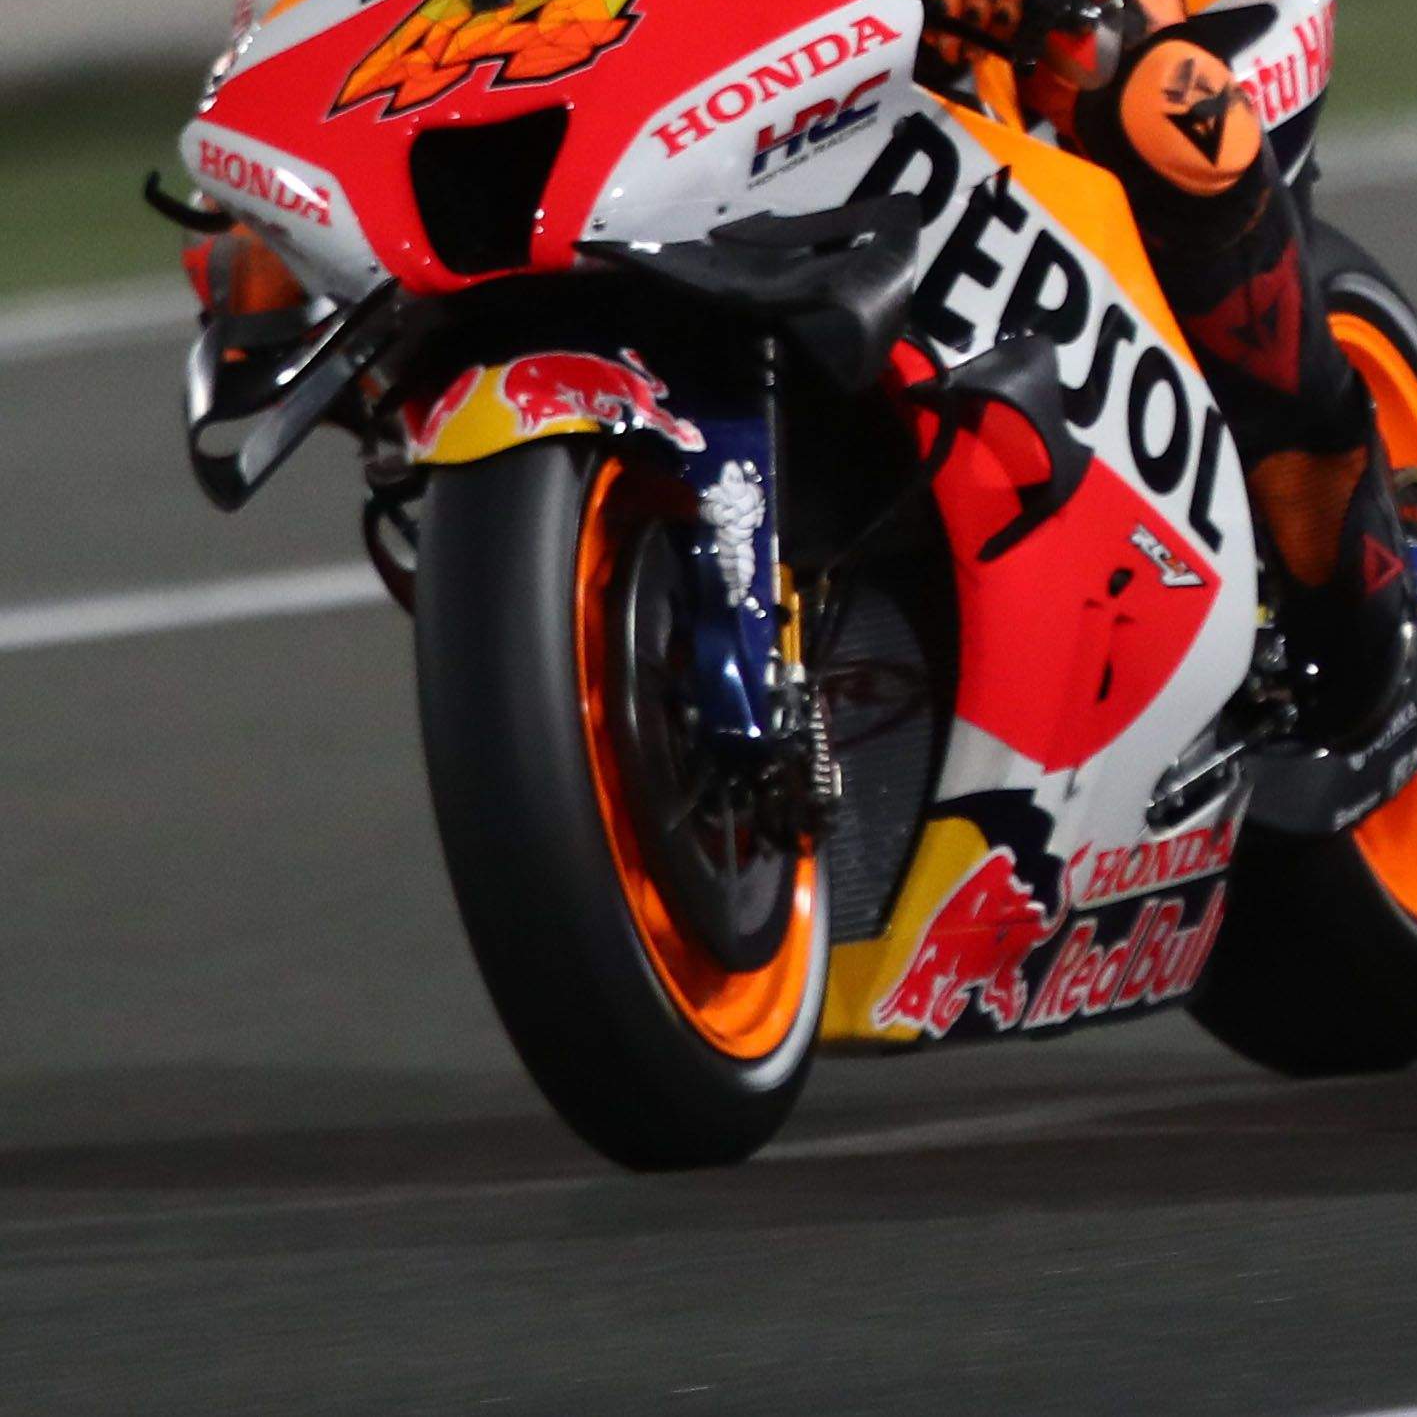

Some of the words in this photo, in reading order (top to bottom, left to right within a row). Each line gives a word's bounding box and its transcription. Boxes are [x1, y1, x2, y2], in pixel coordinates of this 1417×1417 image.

[650, 14, 902, 160] HONDA
[750, 69, 892, 178] HRC
[1082, 819, 1234, 902] HONDA
